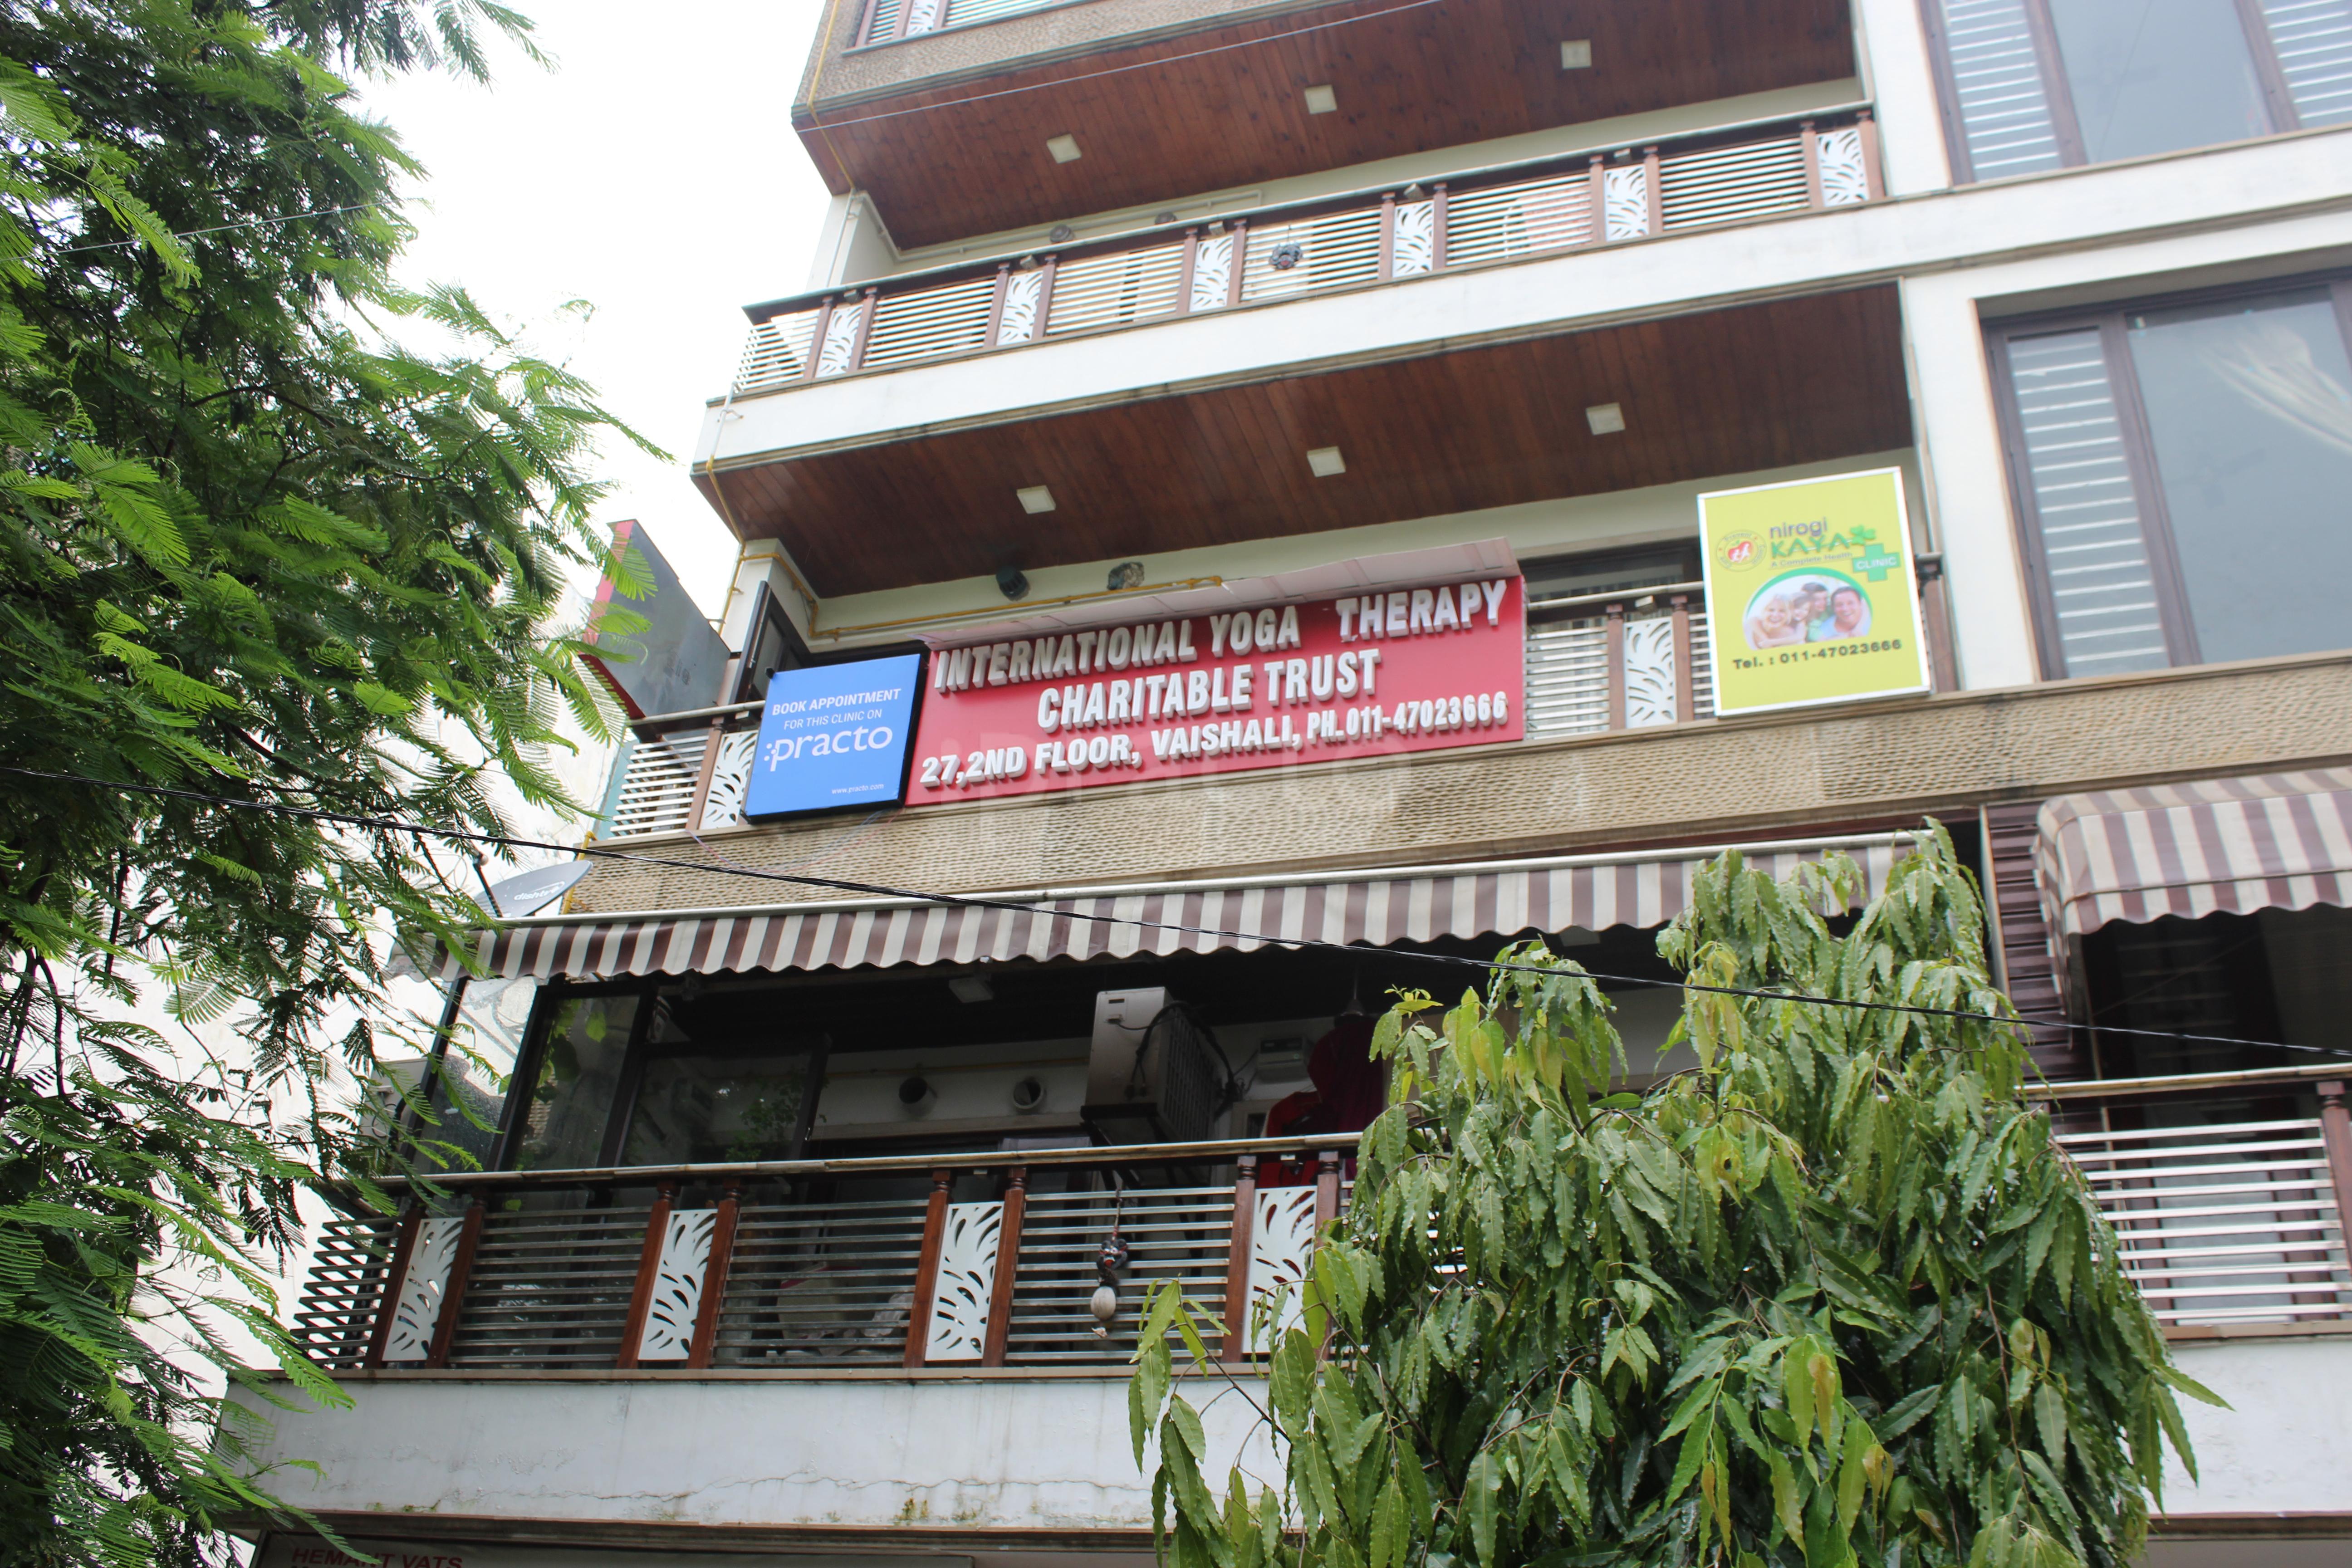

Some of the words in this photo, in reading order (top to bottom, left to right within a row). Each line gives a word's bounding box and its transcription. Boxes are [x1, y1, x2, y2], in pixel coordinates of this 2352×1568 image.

[1770, 517, 1828, 539] nirogi
[1771, 533, 1850, 559] KAYA
[1780, 557, 1821, 567] Complete
[1856, 556, 1897, 570] CLINIC
[934, 619, 1197, 693] INTERNATIONAL
[1210, 605, 1301, 658] YOGA
[1336, 579, 1507, 642] THERAPY
[1780, 639, 1902, 664] 011-47023666
[772, 701, 807, 716] BOOK
[809, 688, 901, 711] APPOINTMENT
[1038, 664, 1253, 734] CHARITABLE
[1264, 648, 1380, 707] TRUST
[784, 719, 804, 730] FOR
[806, 715, 829, 727] THIS
[831, 711, 864, 724] CLINIC
[867, 709, 882, 720] ON
[1034, 734, 1142, 774] FLOOR,
[1151, 715, 1303, 761] VAISHALI,
[832, 783, 884, 795] www.practo.com
